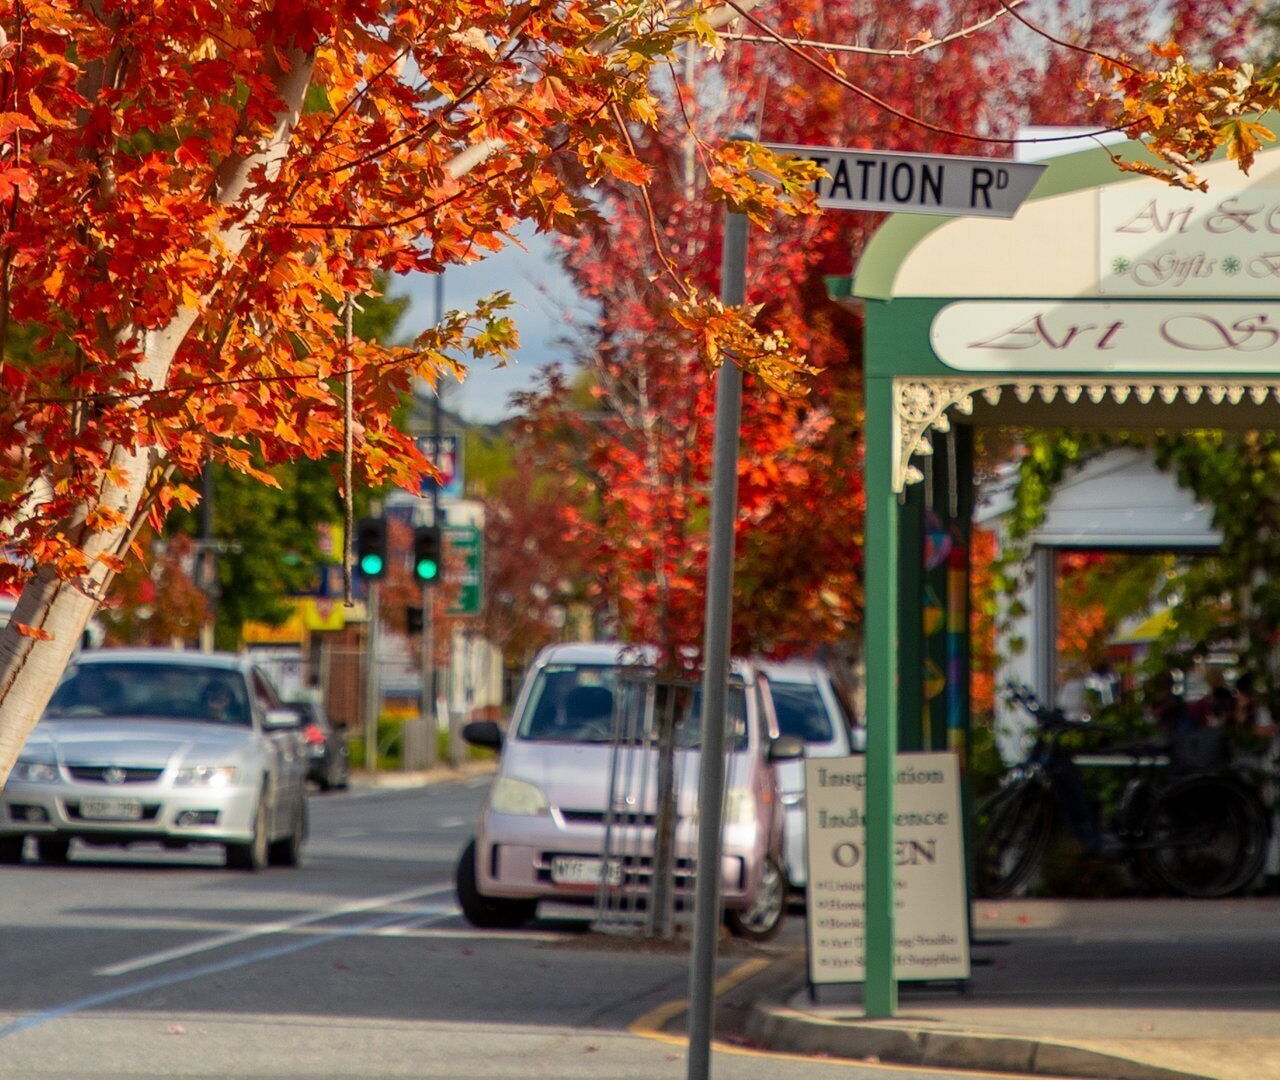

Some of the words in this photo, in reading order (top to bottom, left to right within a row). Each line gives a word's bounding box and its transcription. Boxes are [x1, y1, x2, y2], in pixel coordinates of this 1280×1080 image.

[791, 156, 945, 206] TATION
[1114, 197, 1194, 234] Art
[1130, 249, 1217, 287] Gifts
[966, 312, 1125, 350] Art
[832, 839, 938, 868] OEN
